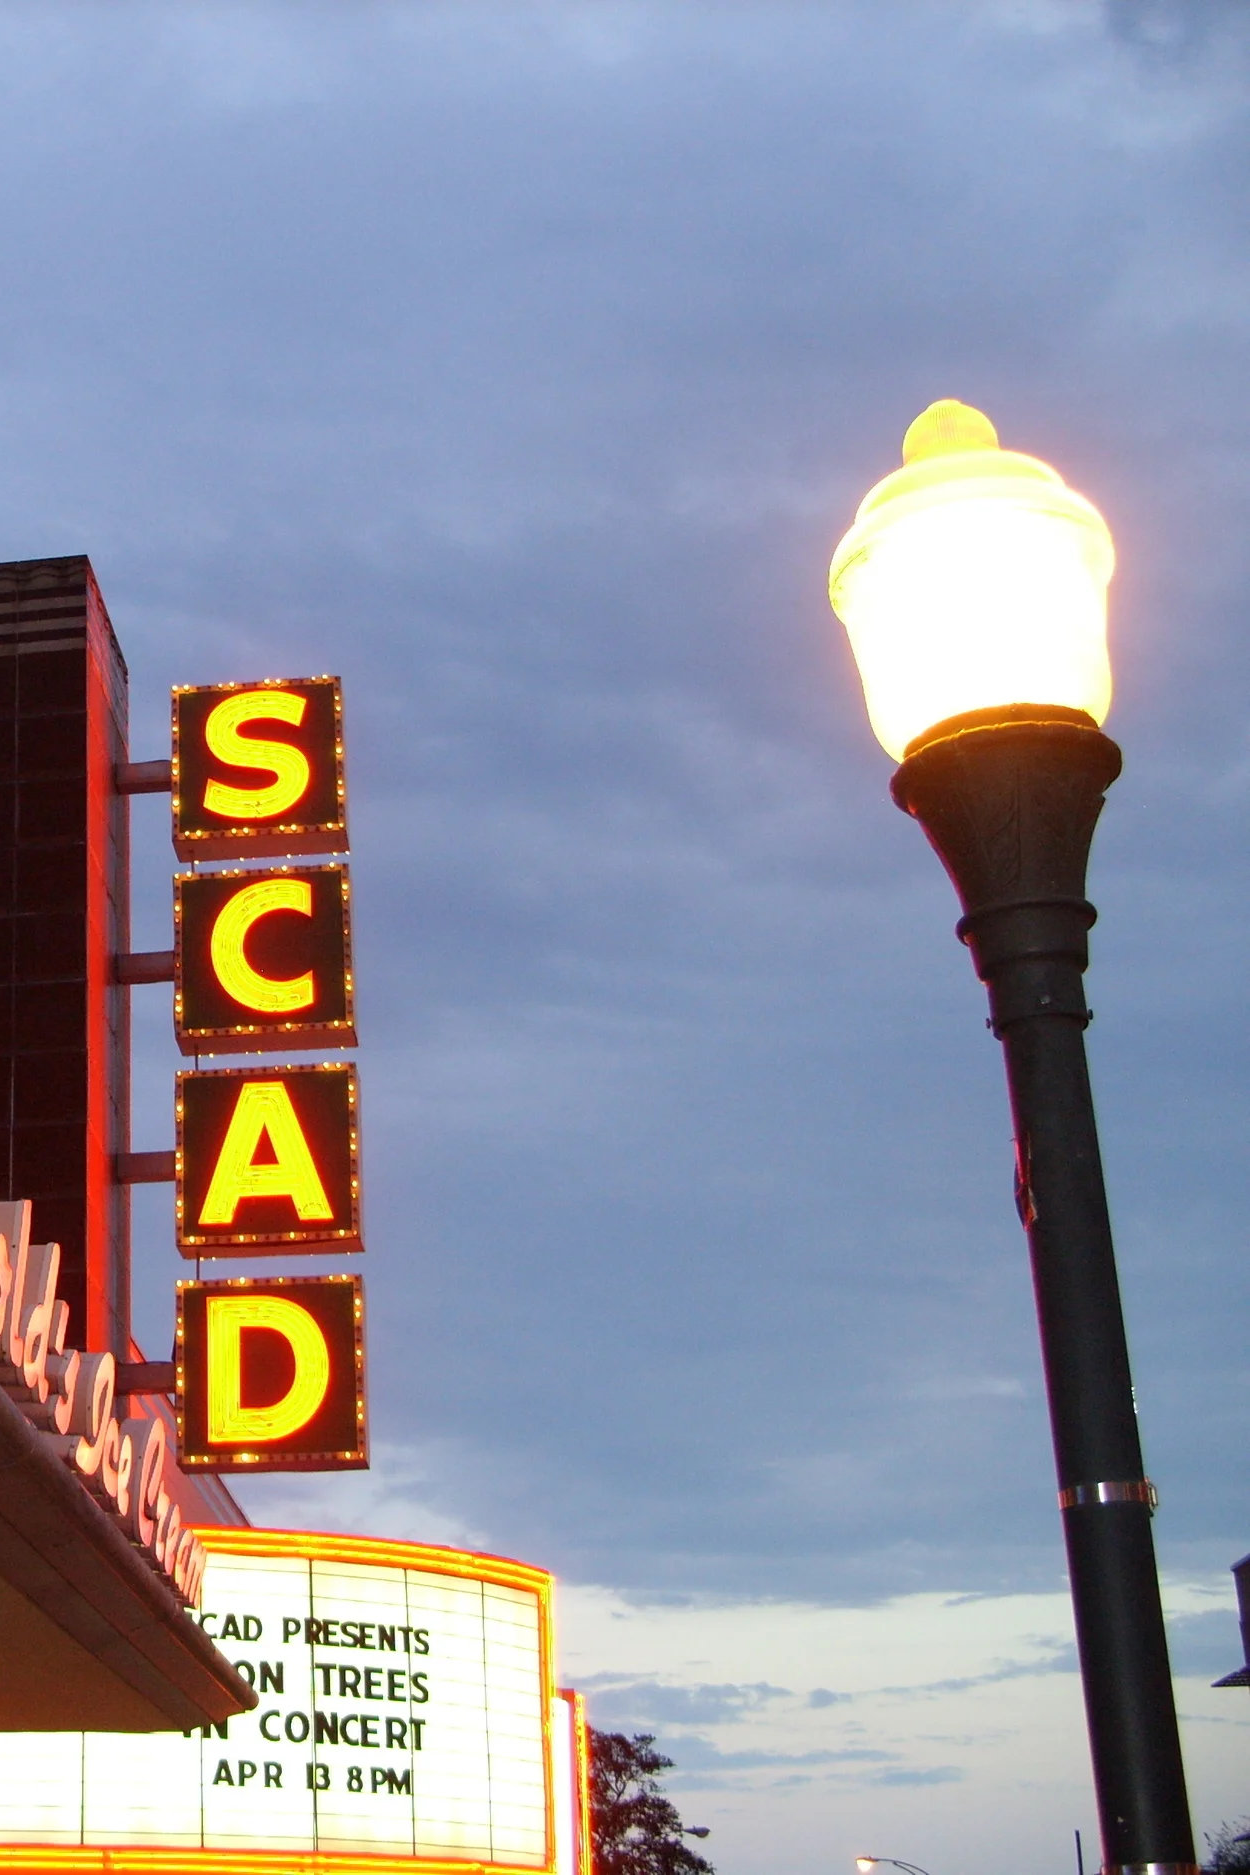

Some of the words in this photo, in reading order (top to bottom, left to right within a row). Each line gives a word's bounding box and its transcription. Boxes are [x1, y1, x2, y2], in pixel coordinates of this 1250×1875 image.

[198, 687, 333, 1444] SCAD
[76, 1352, 132, 1516] Ice
[138, 1417, 207, 1610] Cream
[185, 1611, 263, 1642] CAD
[282, 1616, 430, 1655] PRESENTS
[315, 1662, 430, 1704] TREES
[259, 1709, 427, 1751] CONCERT
[212, 1758, 283, 1788] APR
[306, 1762, 331, 1790] 13
